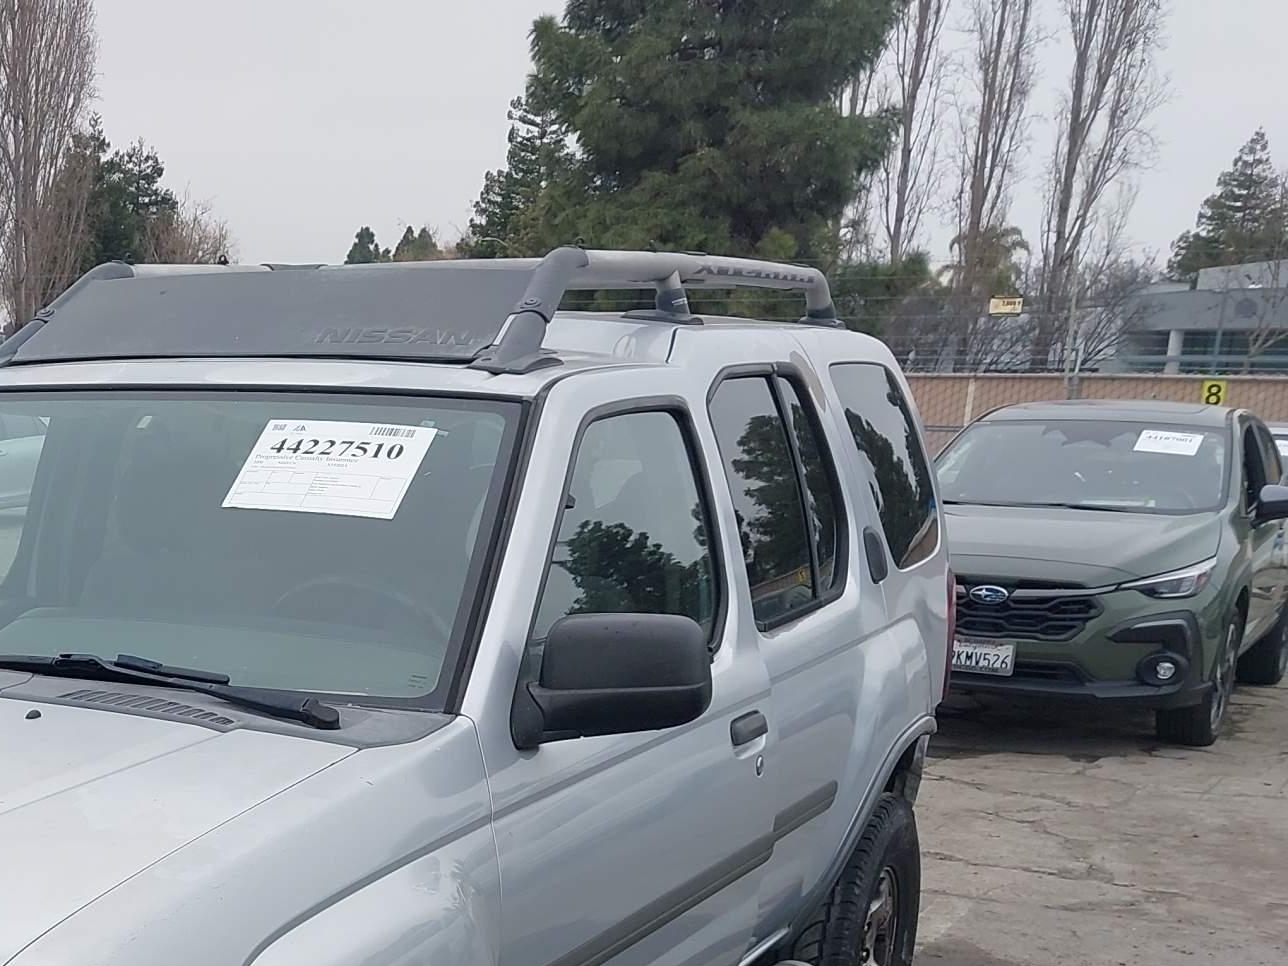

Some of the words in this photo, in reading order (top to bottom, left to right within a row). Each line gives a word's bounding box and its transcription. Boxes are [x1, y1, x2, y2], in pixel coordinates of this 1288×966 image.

[314, 326, 473, 346] NISSAN
[1205, 383, 1222, 405] 8
[270, 438, 405, 460] 44227510
